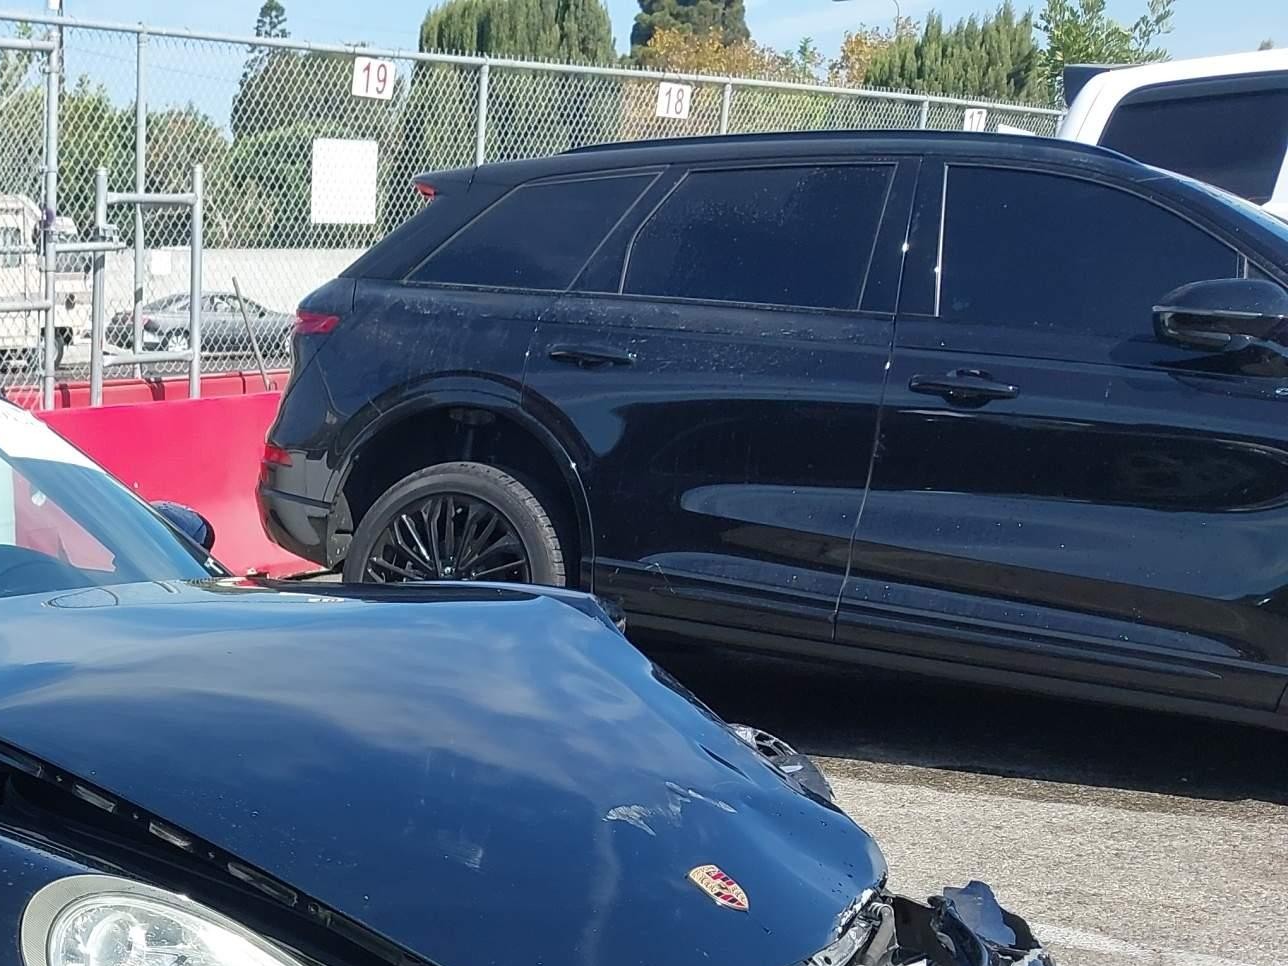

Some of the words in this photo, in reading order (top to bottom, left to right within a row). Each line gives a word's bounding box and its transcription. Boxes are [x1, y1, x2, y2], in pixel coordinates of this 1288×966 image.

[362, 61, 387, 94] 19
[665, 87, 684, 115] 18
[969, 111, 983, 131] 17
